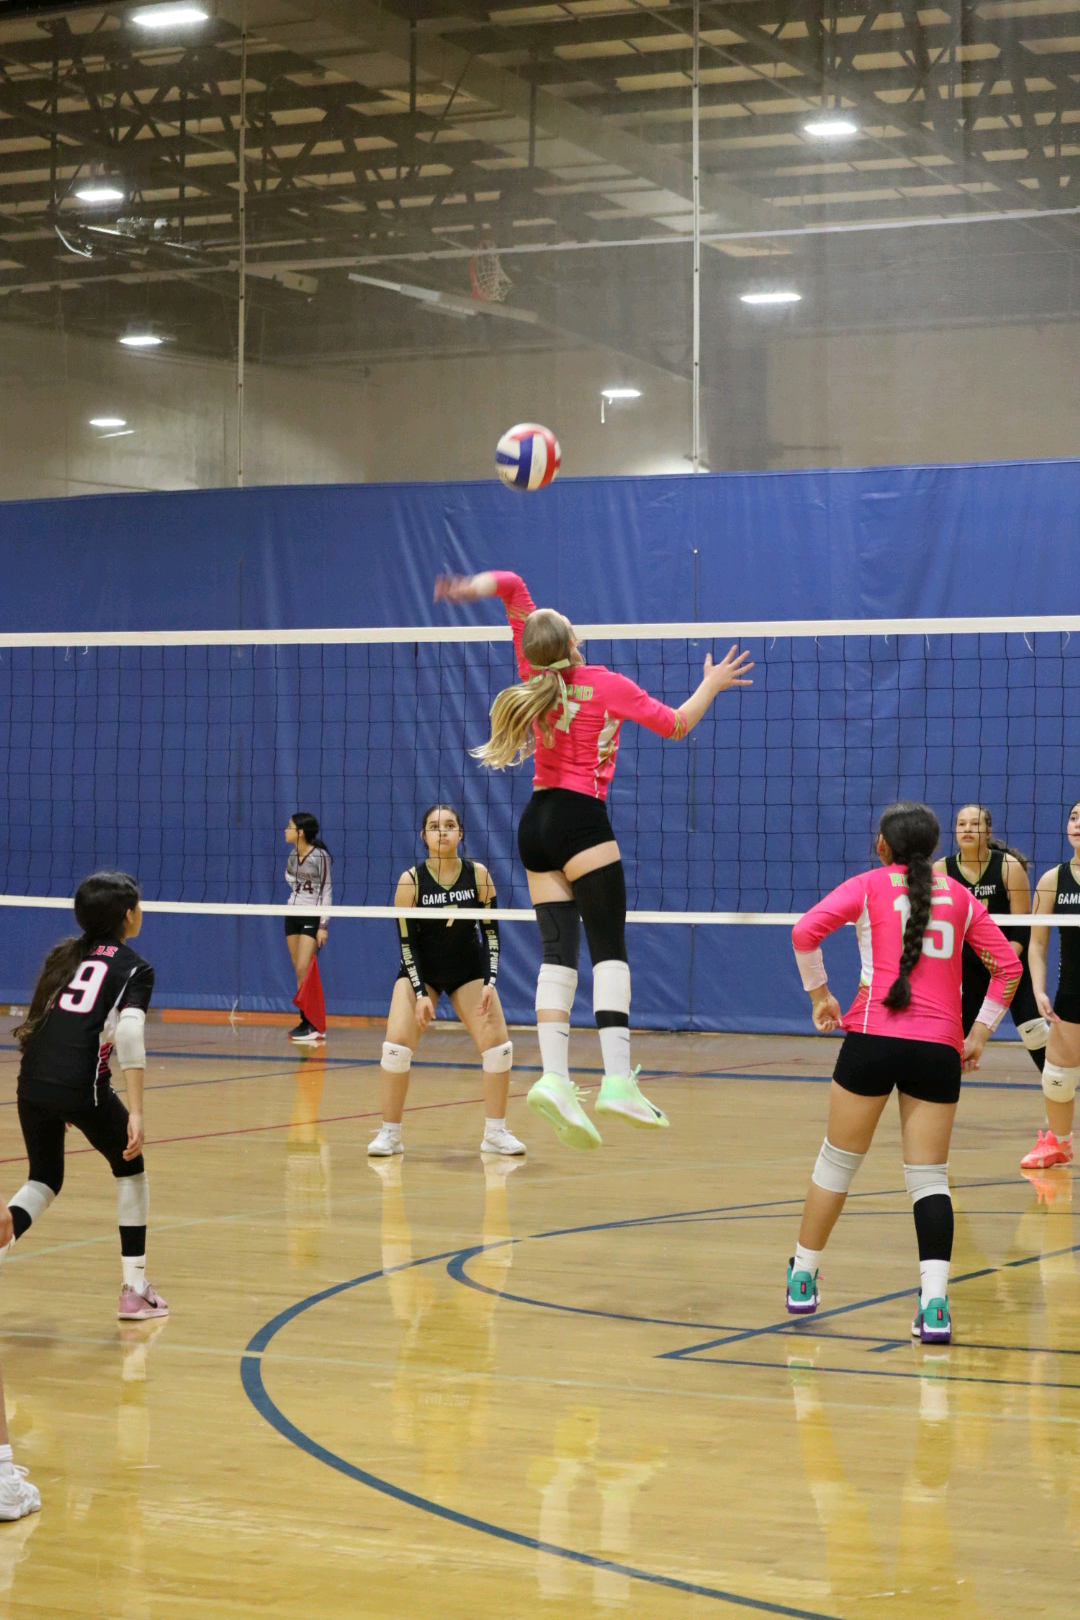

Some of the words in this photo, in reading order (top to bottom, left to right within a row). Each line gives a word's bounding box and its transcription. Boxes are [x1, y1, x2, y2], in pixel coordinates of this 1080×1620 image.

[422, 893, 447, 905] GAME
[449, 889, 475, 902] POINT
[974, 884, 997, 897] POINT
[893, 894, 955, 959] 15
[485, 929, 499, 951] GAME
[401, 943, 415, 966] POINT
[489, 952, 499, 974] POINT
[58, 959, 109, 1014] 9
[407, 965, 421, 988] GAME
